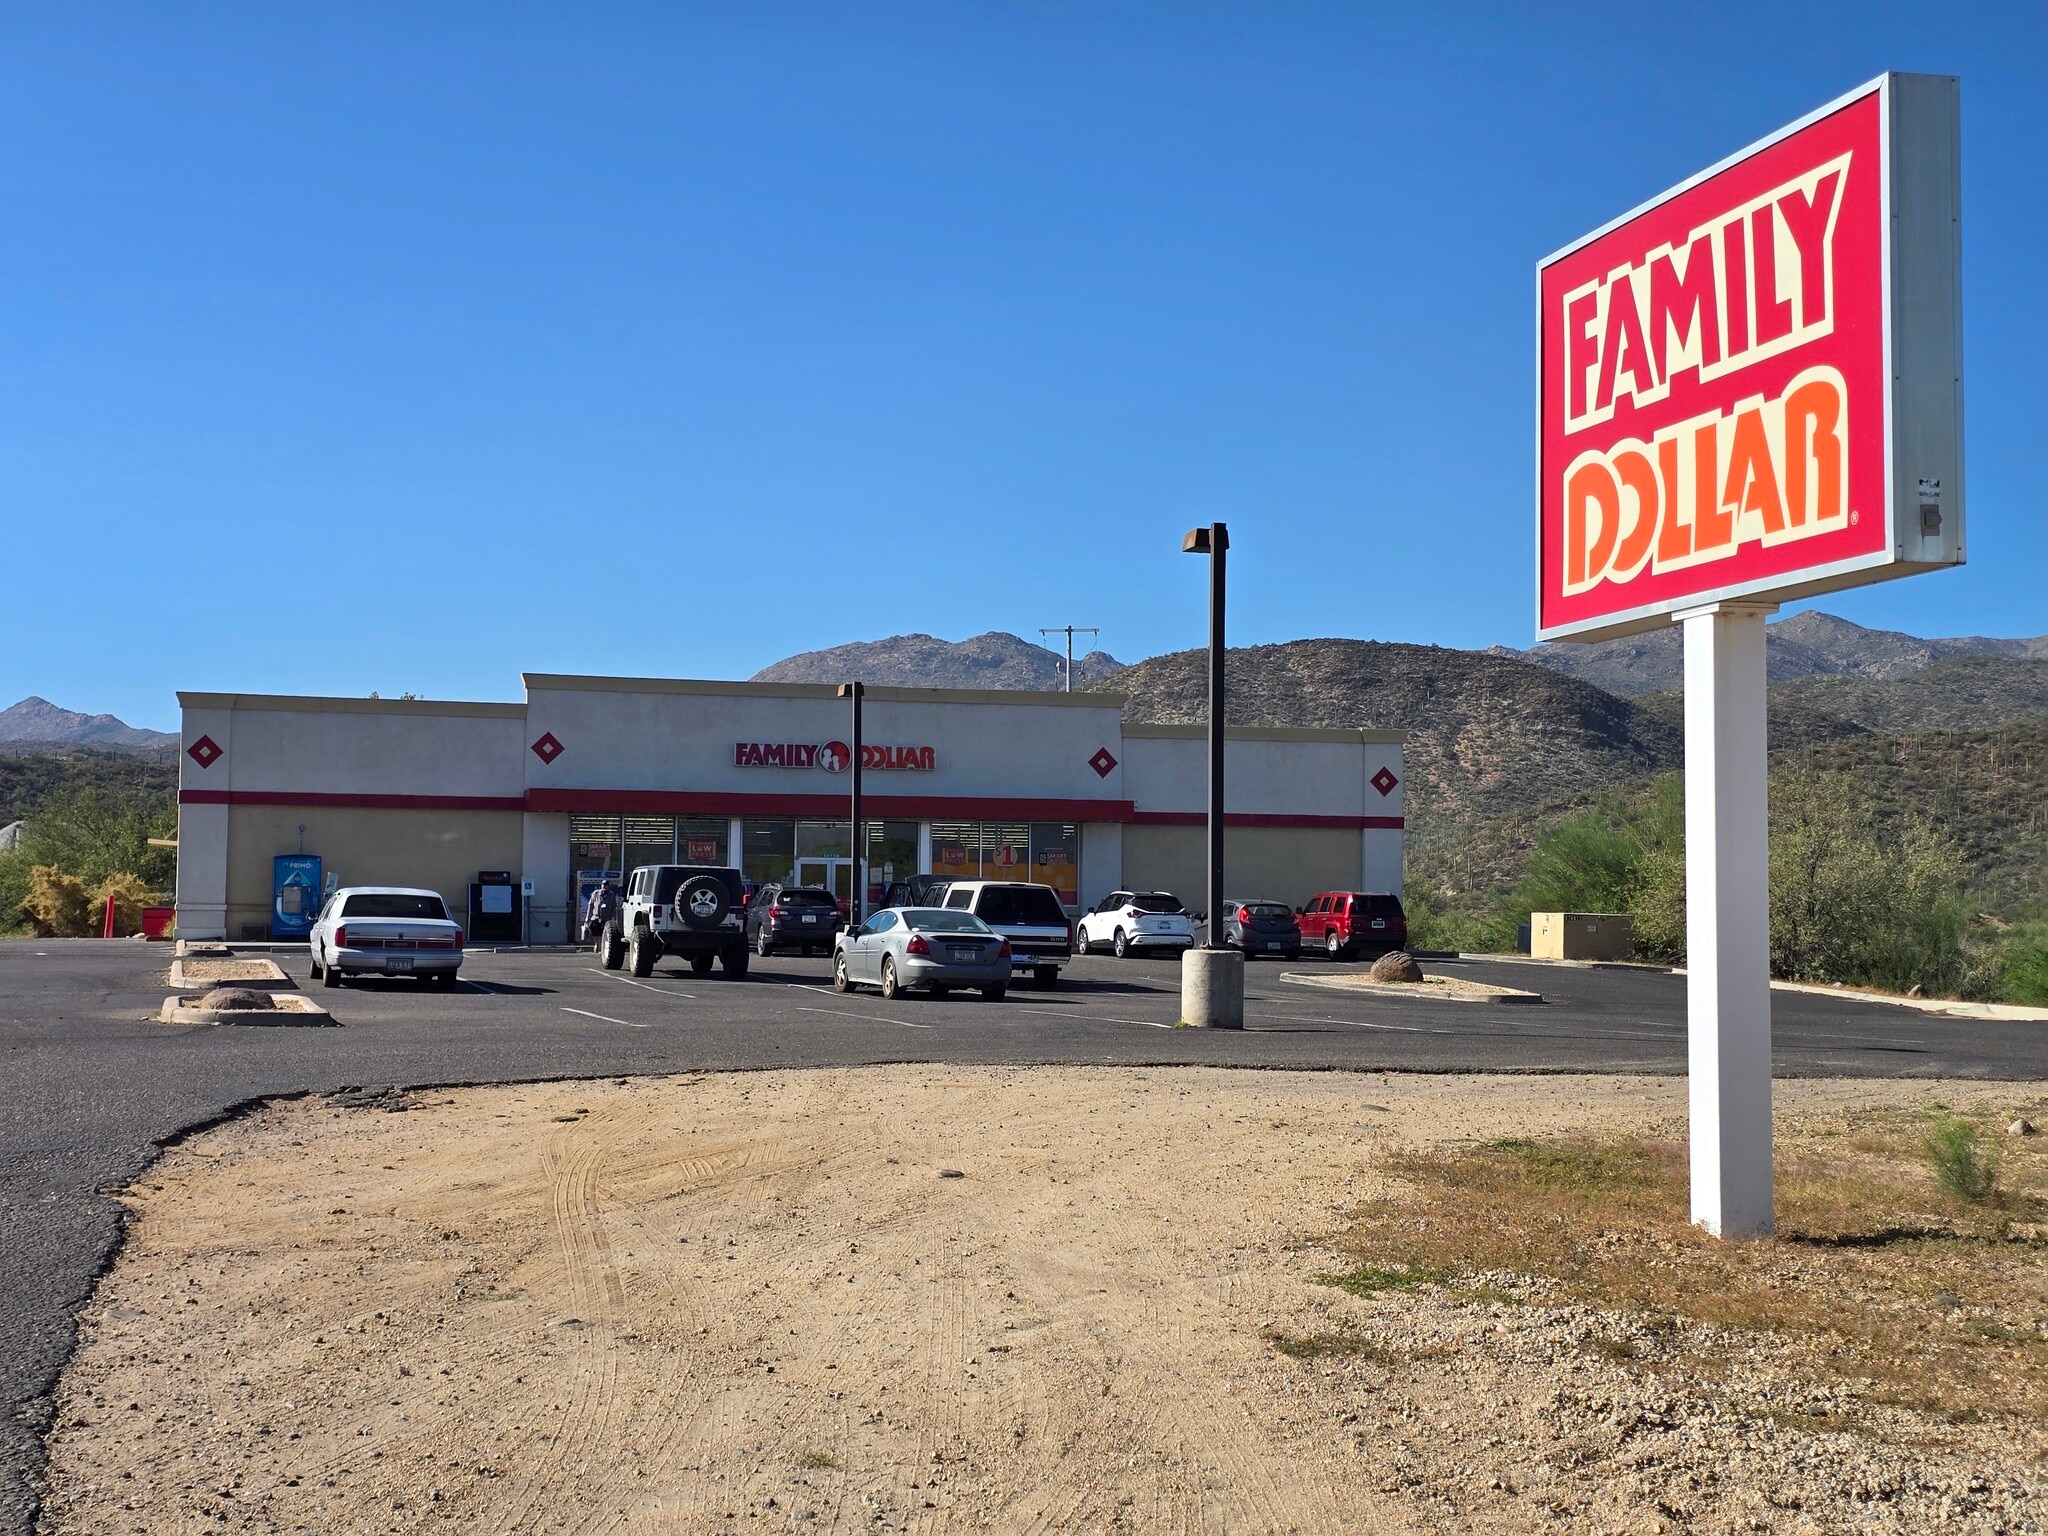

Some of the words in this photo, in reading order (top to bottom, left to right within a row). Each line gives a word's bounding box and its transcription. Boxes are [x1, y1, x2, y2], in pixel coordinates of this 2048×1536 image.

[1563, 150, 1853, 436] FAMILY
[1563, 365, 1849, 597] DOLLAR
[734, 742, 818, 767] FAMILY
[860, 744, 936, 770] DOLLAR
[946, 851, 965, 859] LOW
